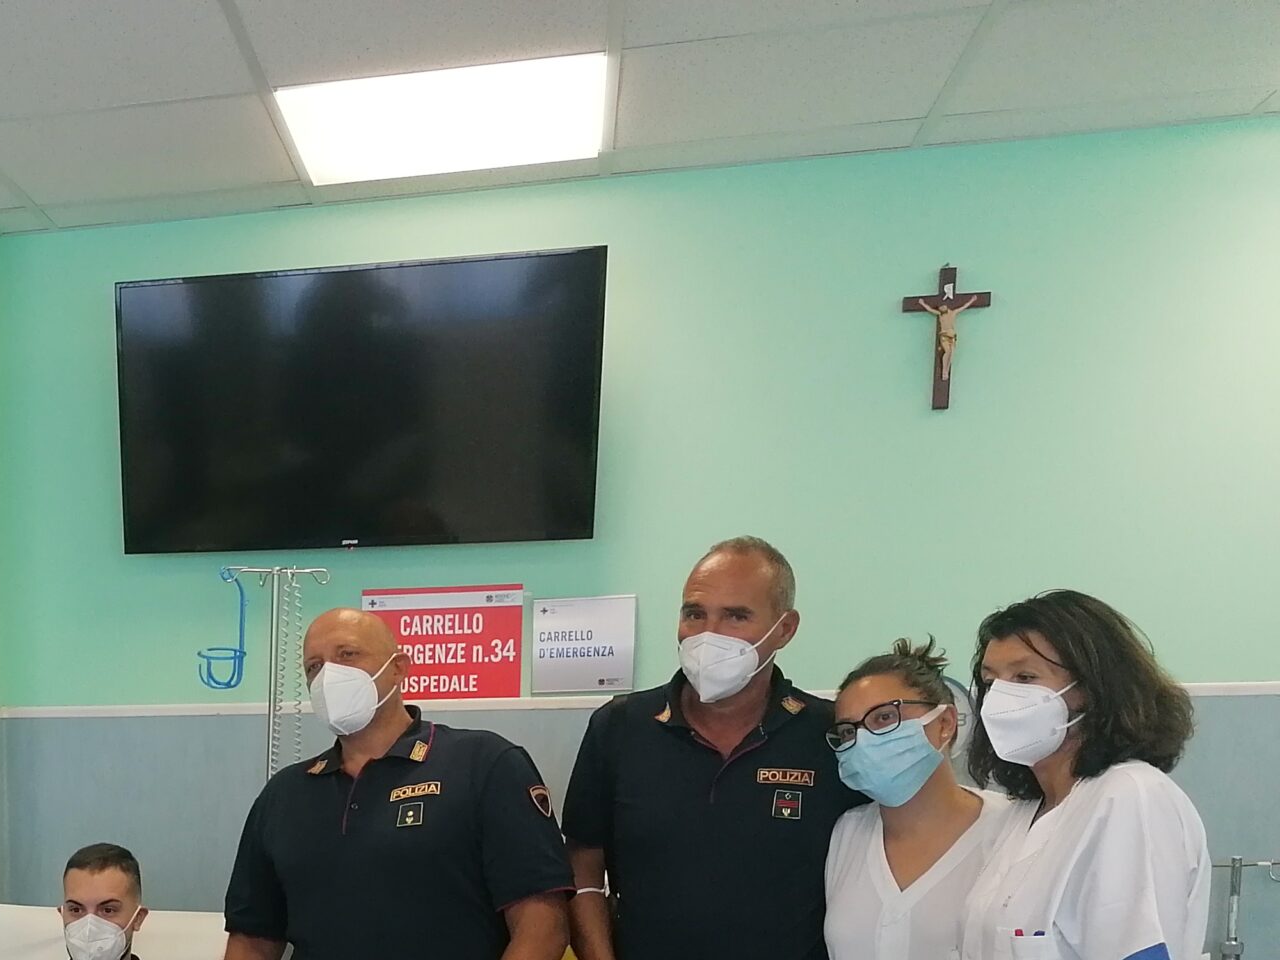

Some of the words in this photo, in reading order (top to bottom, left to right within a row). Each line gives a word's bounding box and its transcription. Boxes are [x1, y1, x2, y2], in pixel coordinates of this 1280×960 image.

[400, 612, 483, 636] CARRELLO
[539, 629, 593, 643] CARRELLO
[397, 642, 466, 665] RGENZE
[472, 638, 516, 663] n.34
[538, 645, 614, 659] D'EMERGENZA
[759, 770, 811, 784] POLIZIA
[392, 783, 438, 799] POLIZIA
